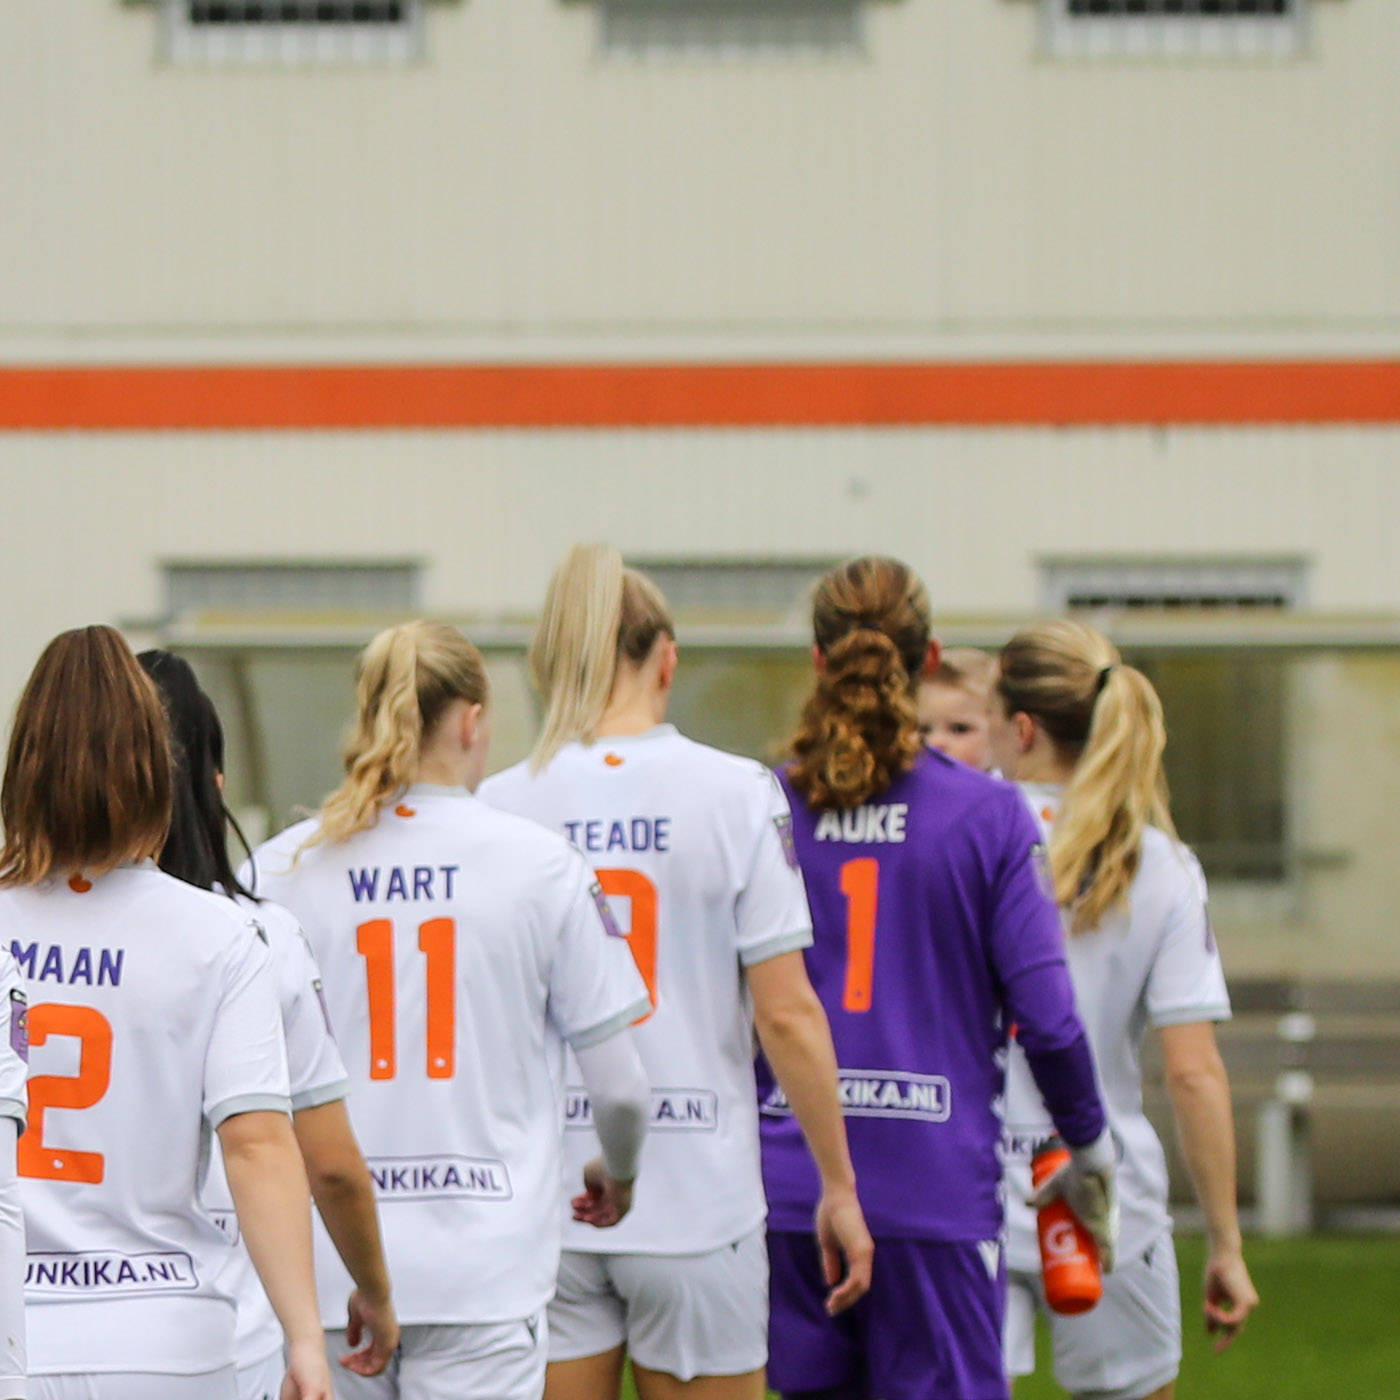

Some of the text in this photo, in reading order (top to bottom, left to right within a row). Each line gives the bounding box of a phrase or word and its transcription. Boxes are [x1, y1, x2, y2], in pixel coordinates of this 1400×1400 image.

[564, 816, 671, 851] TEADE
[813, 803, 908, 843] AUKE
[348, 865, 460, 902] WART
[841, 858, 878, 1012] 1
[356, 917, 456, 1080] 11
[17, 1003, 113, 1184] 2
